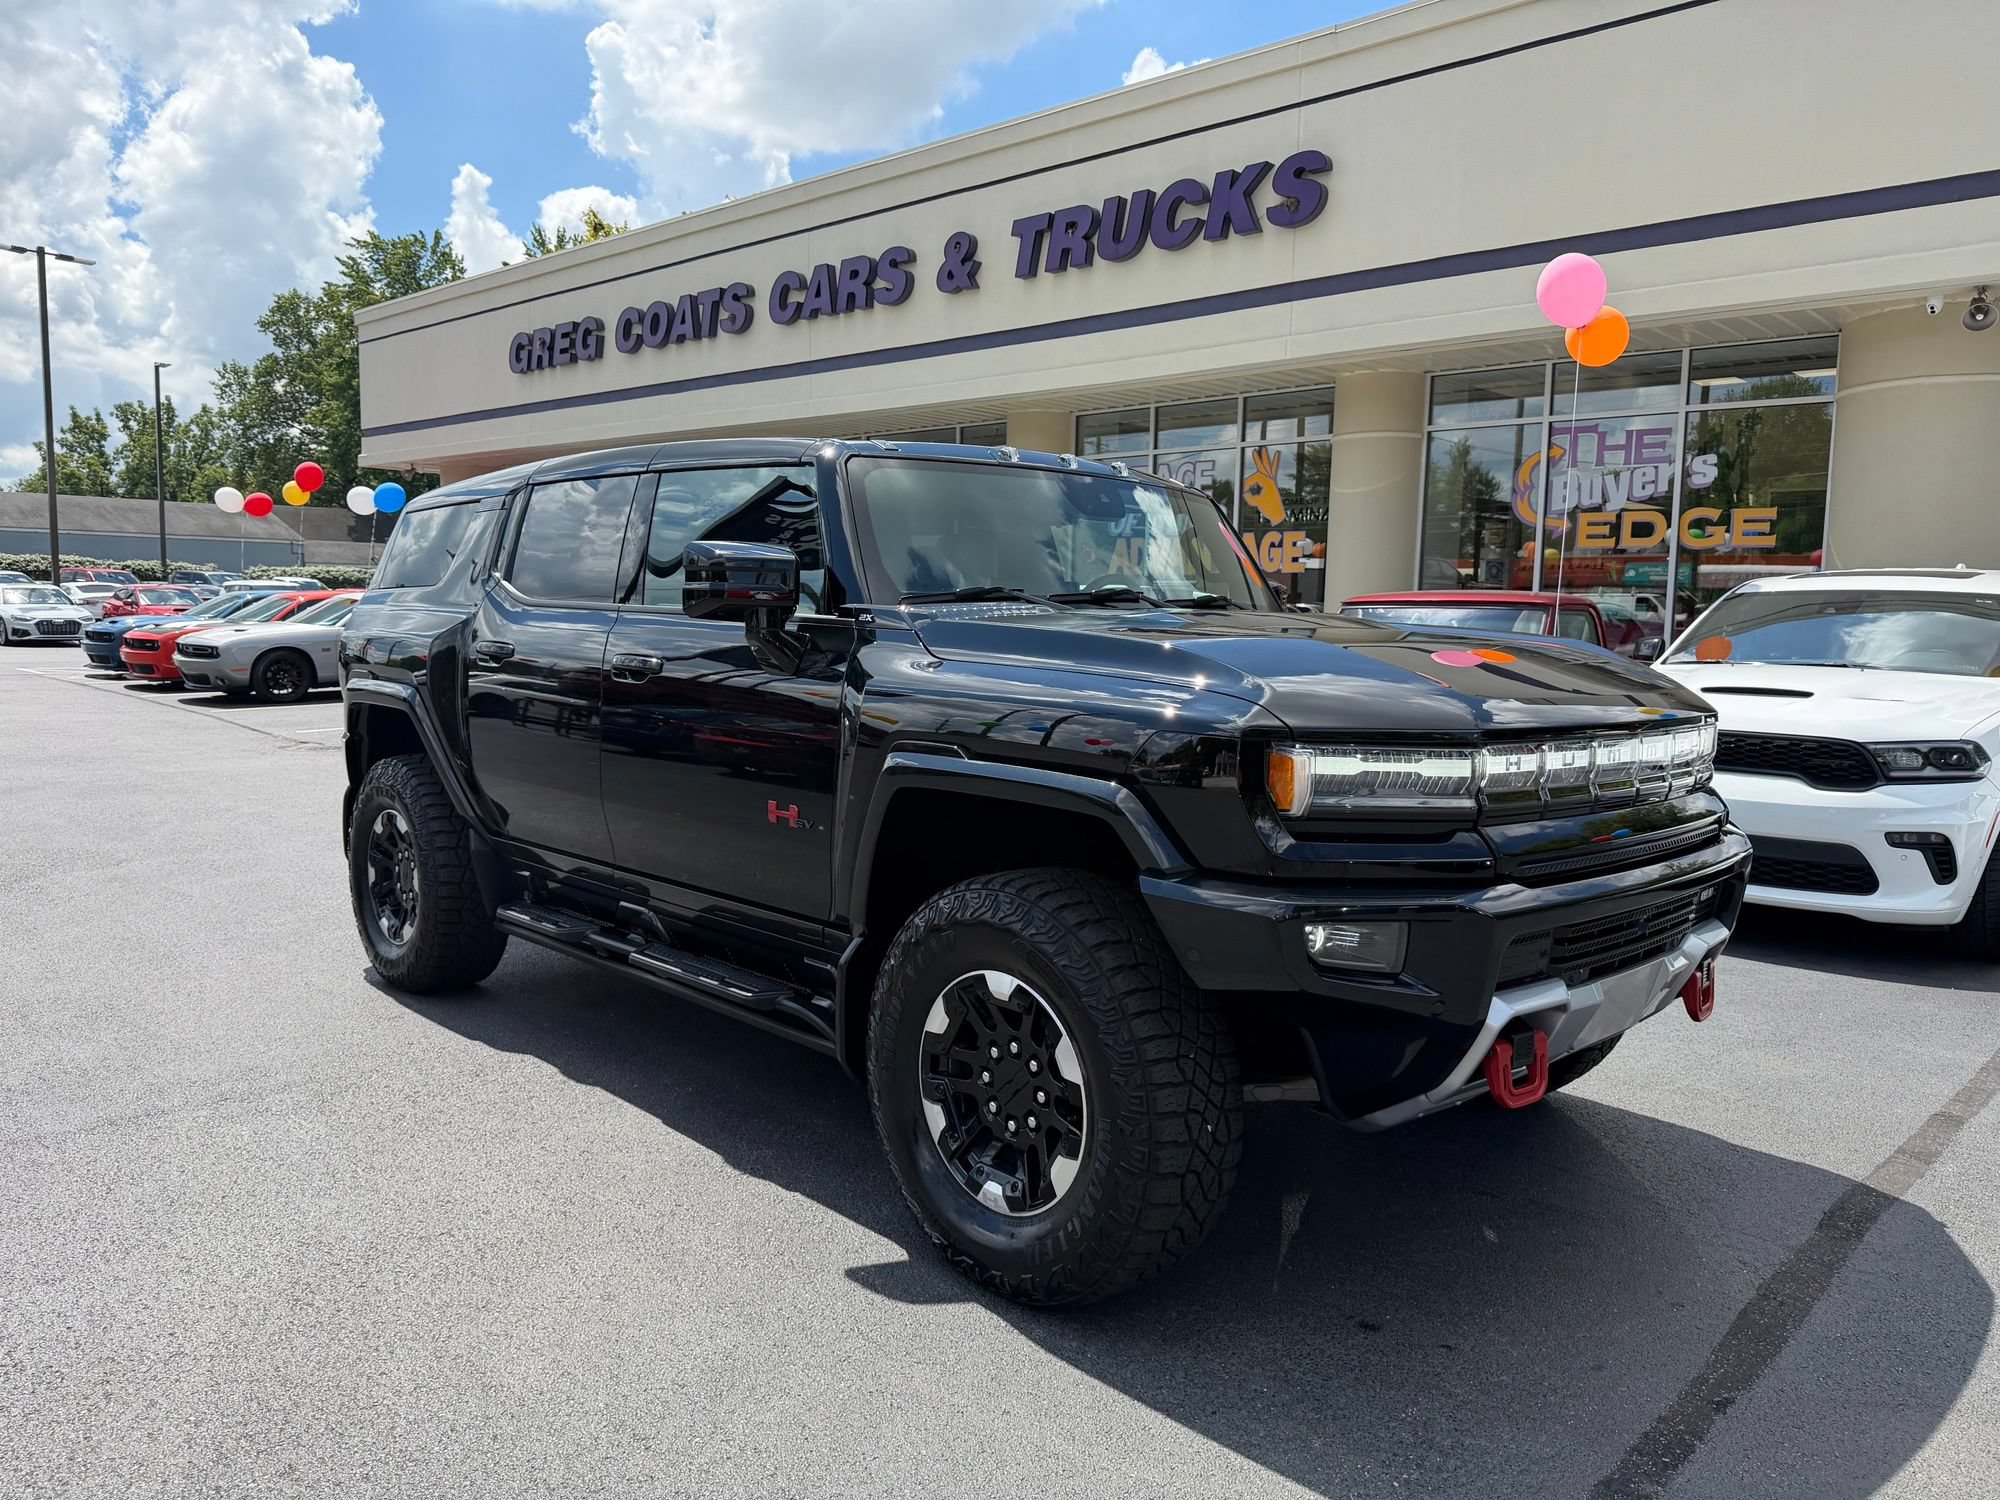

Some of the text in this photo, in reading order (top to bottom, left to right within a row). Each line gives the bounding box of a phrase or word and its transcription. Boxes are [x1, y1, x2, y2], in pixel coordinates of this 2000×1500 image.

[509, 149, 1333, 375] GREG COATS CARS & TRUCKS
[1550, 425, 1673, 469] THE
[1550, 452, 1719, 512] Buyer's
[1576, 506, 1778, 549] EDGE
